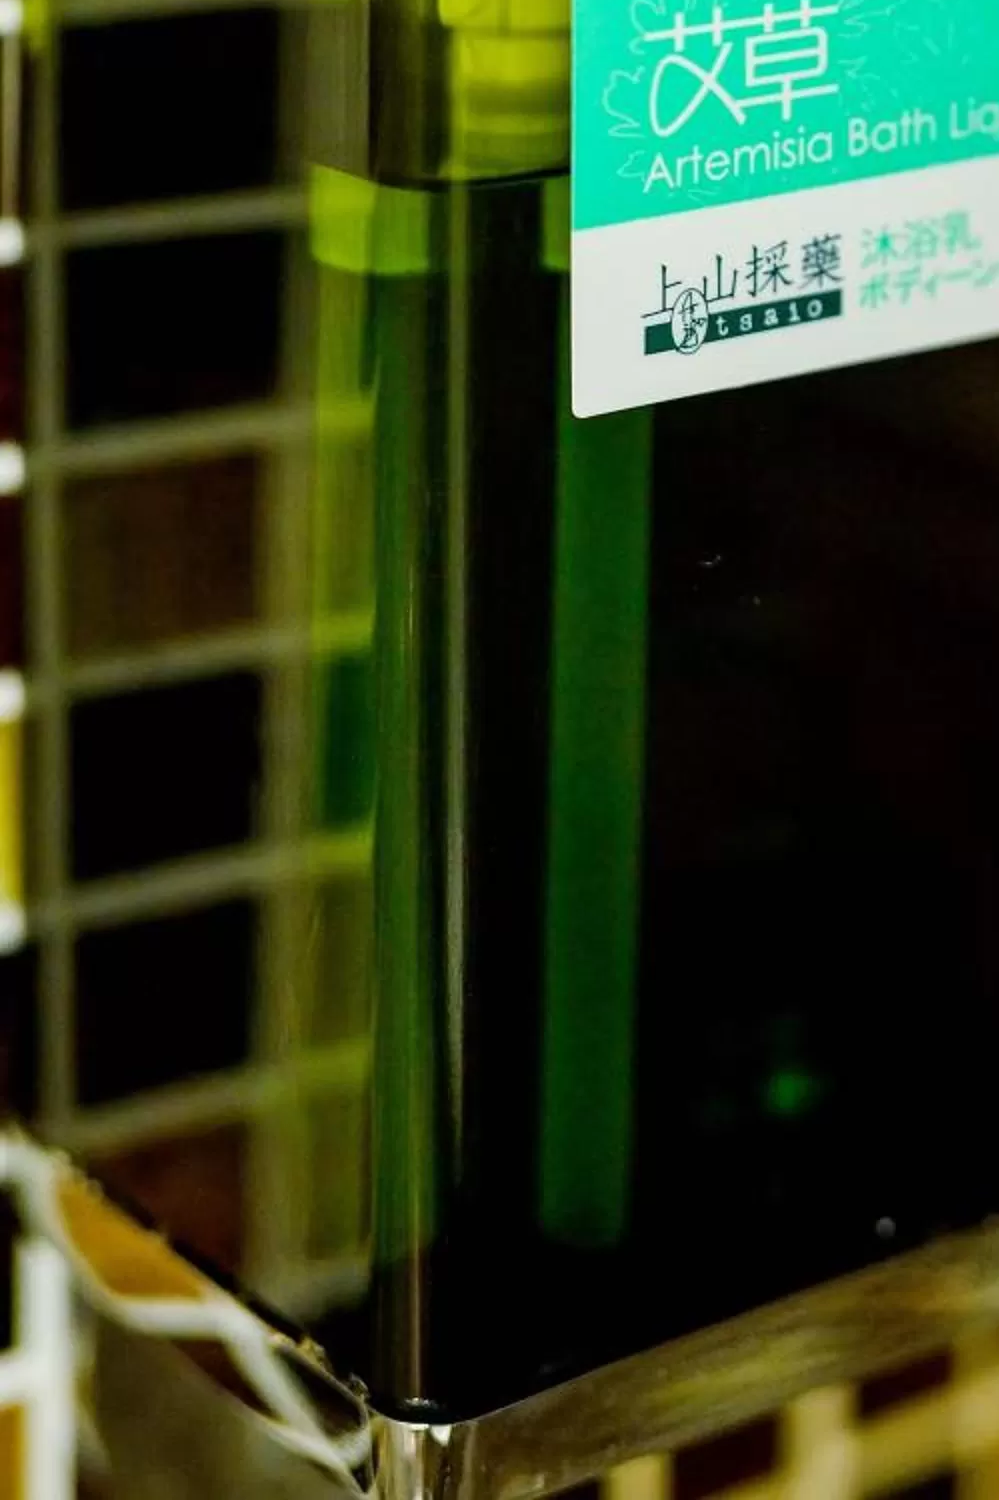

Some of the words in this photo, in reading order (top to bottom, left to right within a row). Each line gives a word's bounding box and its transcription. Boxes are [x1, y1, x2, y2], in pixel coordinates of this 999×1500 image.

[643, 126, 834, 193] Artemisia
[847, 108, 937, 157] Bath
[641, 233, 844, 318] 上山採藥
[860, 212, 982, 269] 沐浴乳
[714, 299, 824, 337] tsaio
